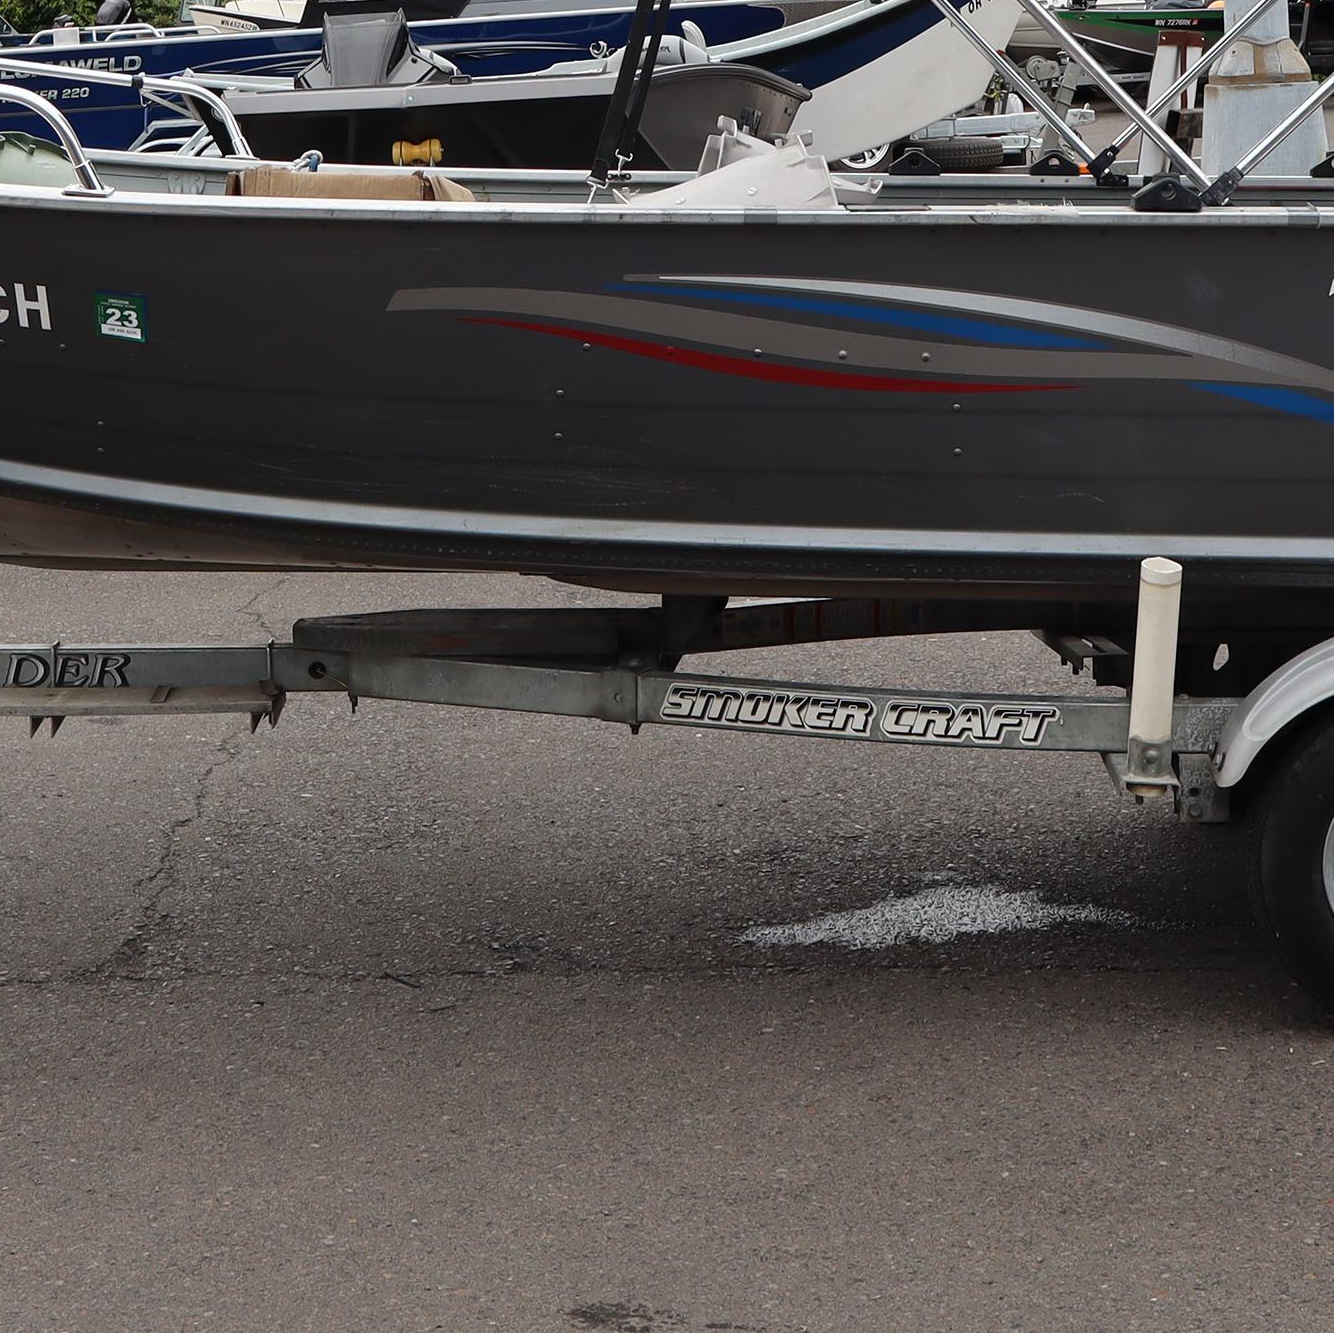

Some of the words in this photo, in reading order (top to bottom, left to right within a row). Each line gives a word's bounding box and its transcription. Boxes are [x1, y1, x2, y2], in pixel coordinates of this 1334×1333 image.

[62, 87, 90, 99] 220
[105, 308, 139, 328] 23
[662, 685, 873, 732] SMOKER
[881, 701, 1058, 743] CRAFT
